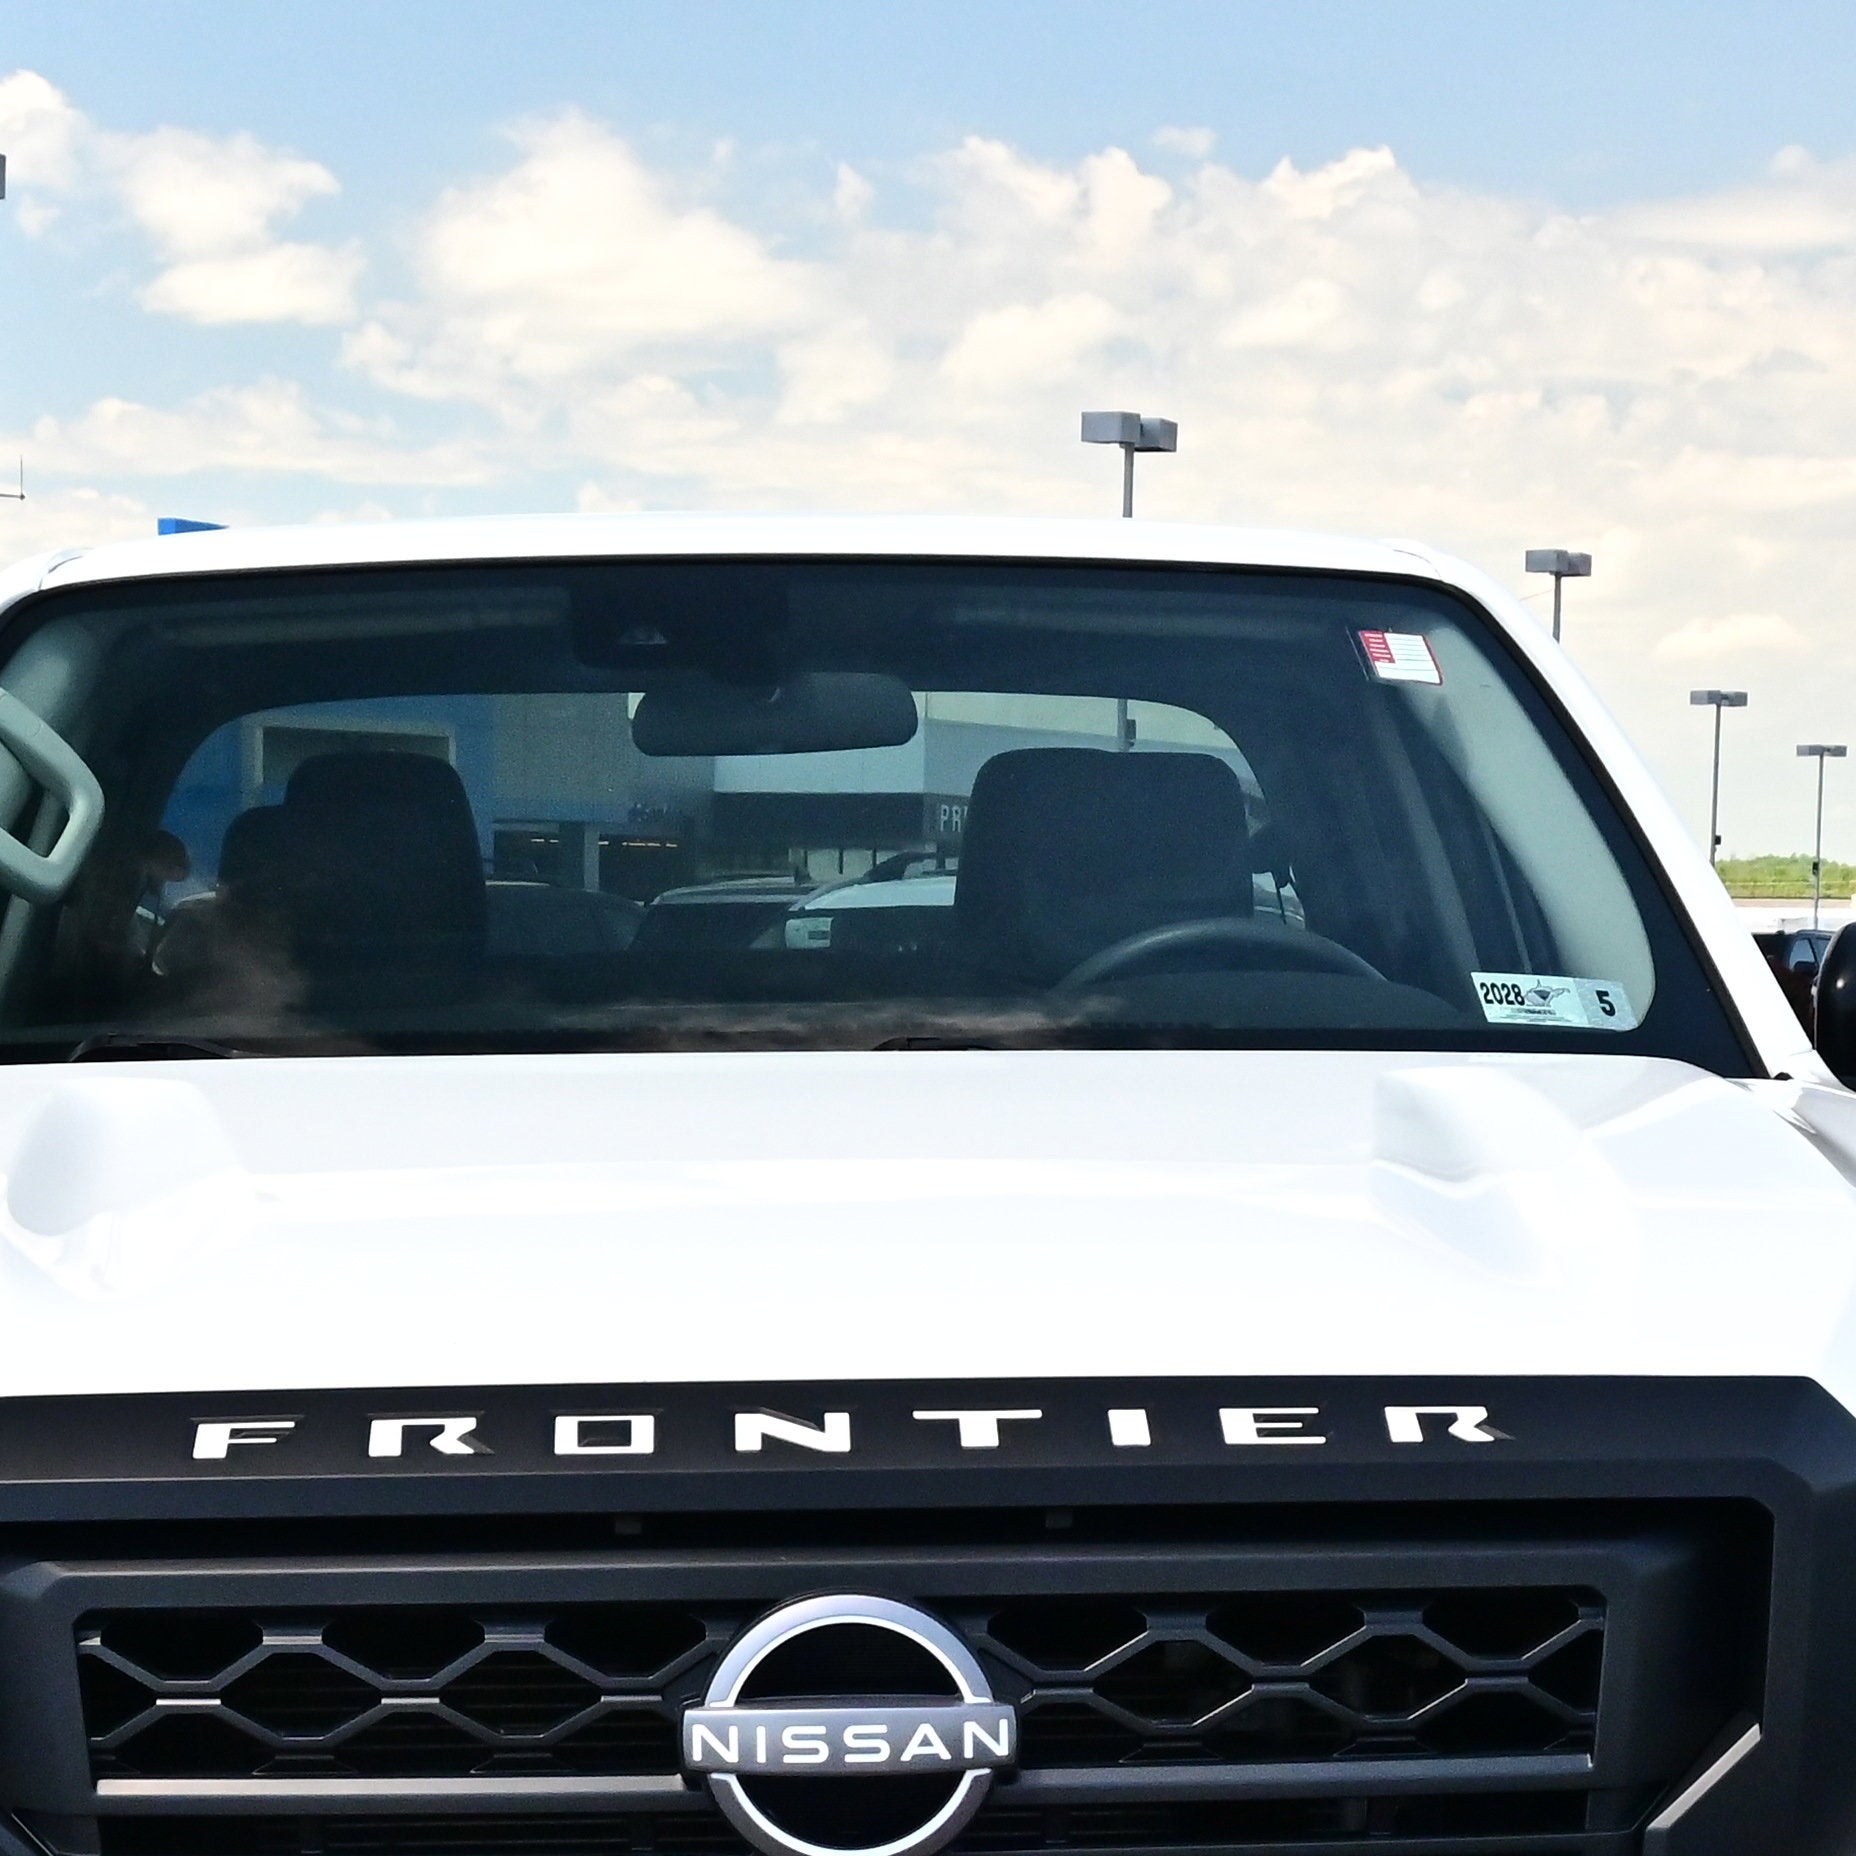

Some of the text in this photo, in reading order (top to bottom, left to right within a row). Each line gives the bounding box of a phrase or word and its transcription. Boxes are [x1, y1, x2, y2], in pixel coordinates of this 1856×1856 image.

[1480, 982, 1526, 1006] 2028
[1595, 989, 1616, 1017] 5
[192, 1404, 1510, 1460] FRONTIER
[691, 1718, 1010, 1764] NISSAN
